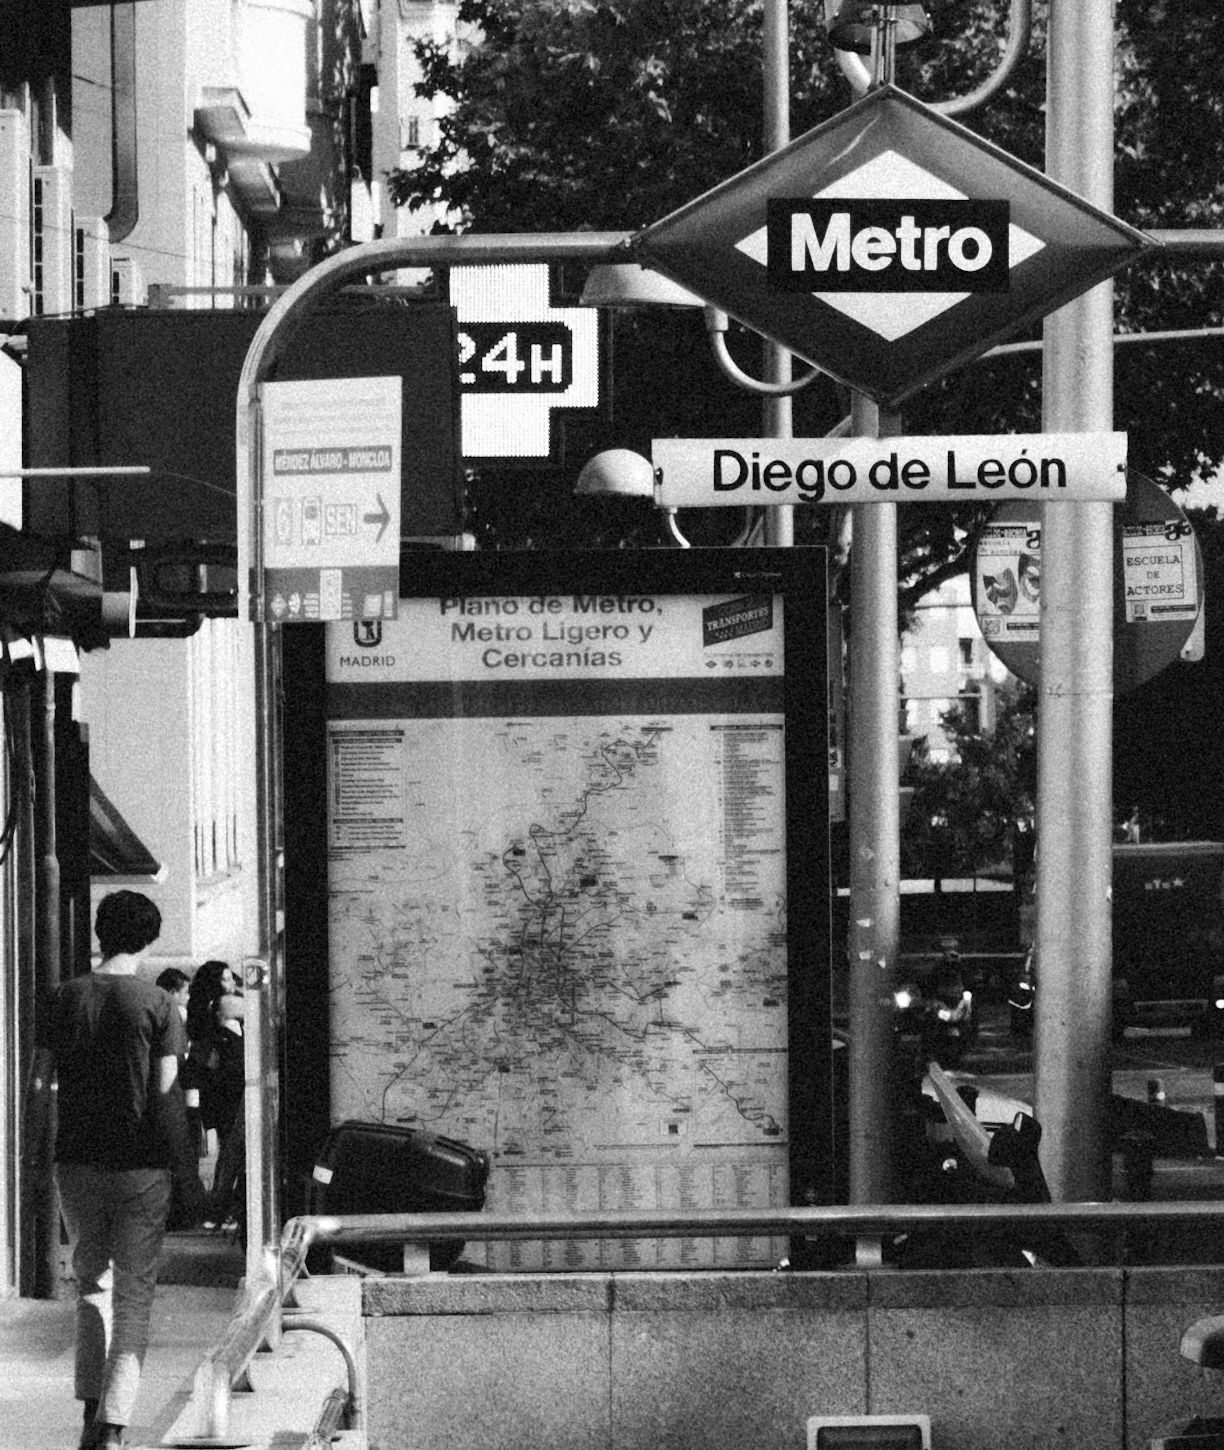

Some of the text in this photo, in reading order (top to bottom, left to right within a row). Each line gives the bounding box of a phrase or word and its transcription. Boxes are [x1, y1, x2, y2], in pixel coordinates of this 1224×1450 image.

[790, 212, 994, 273] Metro
[275, 449, 310, 471] MÉNDEZ
[310, 448, 343, 470] ÁLVARO
[348, 450, 391, 468] MONCLOA
[713, 448, 1067, 502] Diego de León
[1126, 555, 1181, 567] ESCUELA
[1146, 570, 1160, 580] DE
[1126, 584, 1185, 597] ACTORES
[440, 595, 663, 617] Plano de Metro,
[706, 605, 769, 632] TRANSPORTES
[450, 621, 655, 647] Metro Ligero y
[340, 654, 396, 667] MADRID
[481, 648, 623, 669] Cercanías
